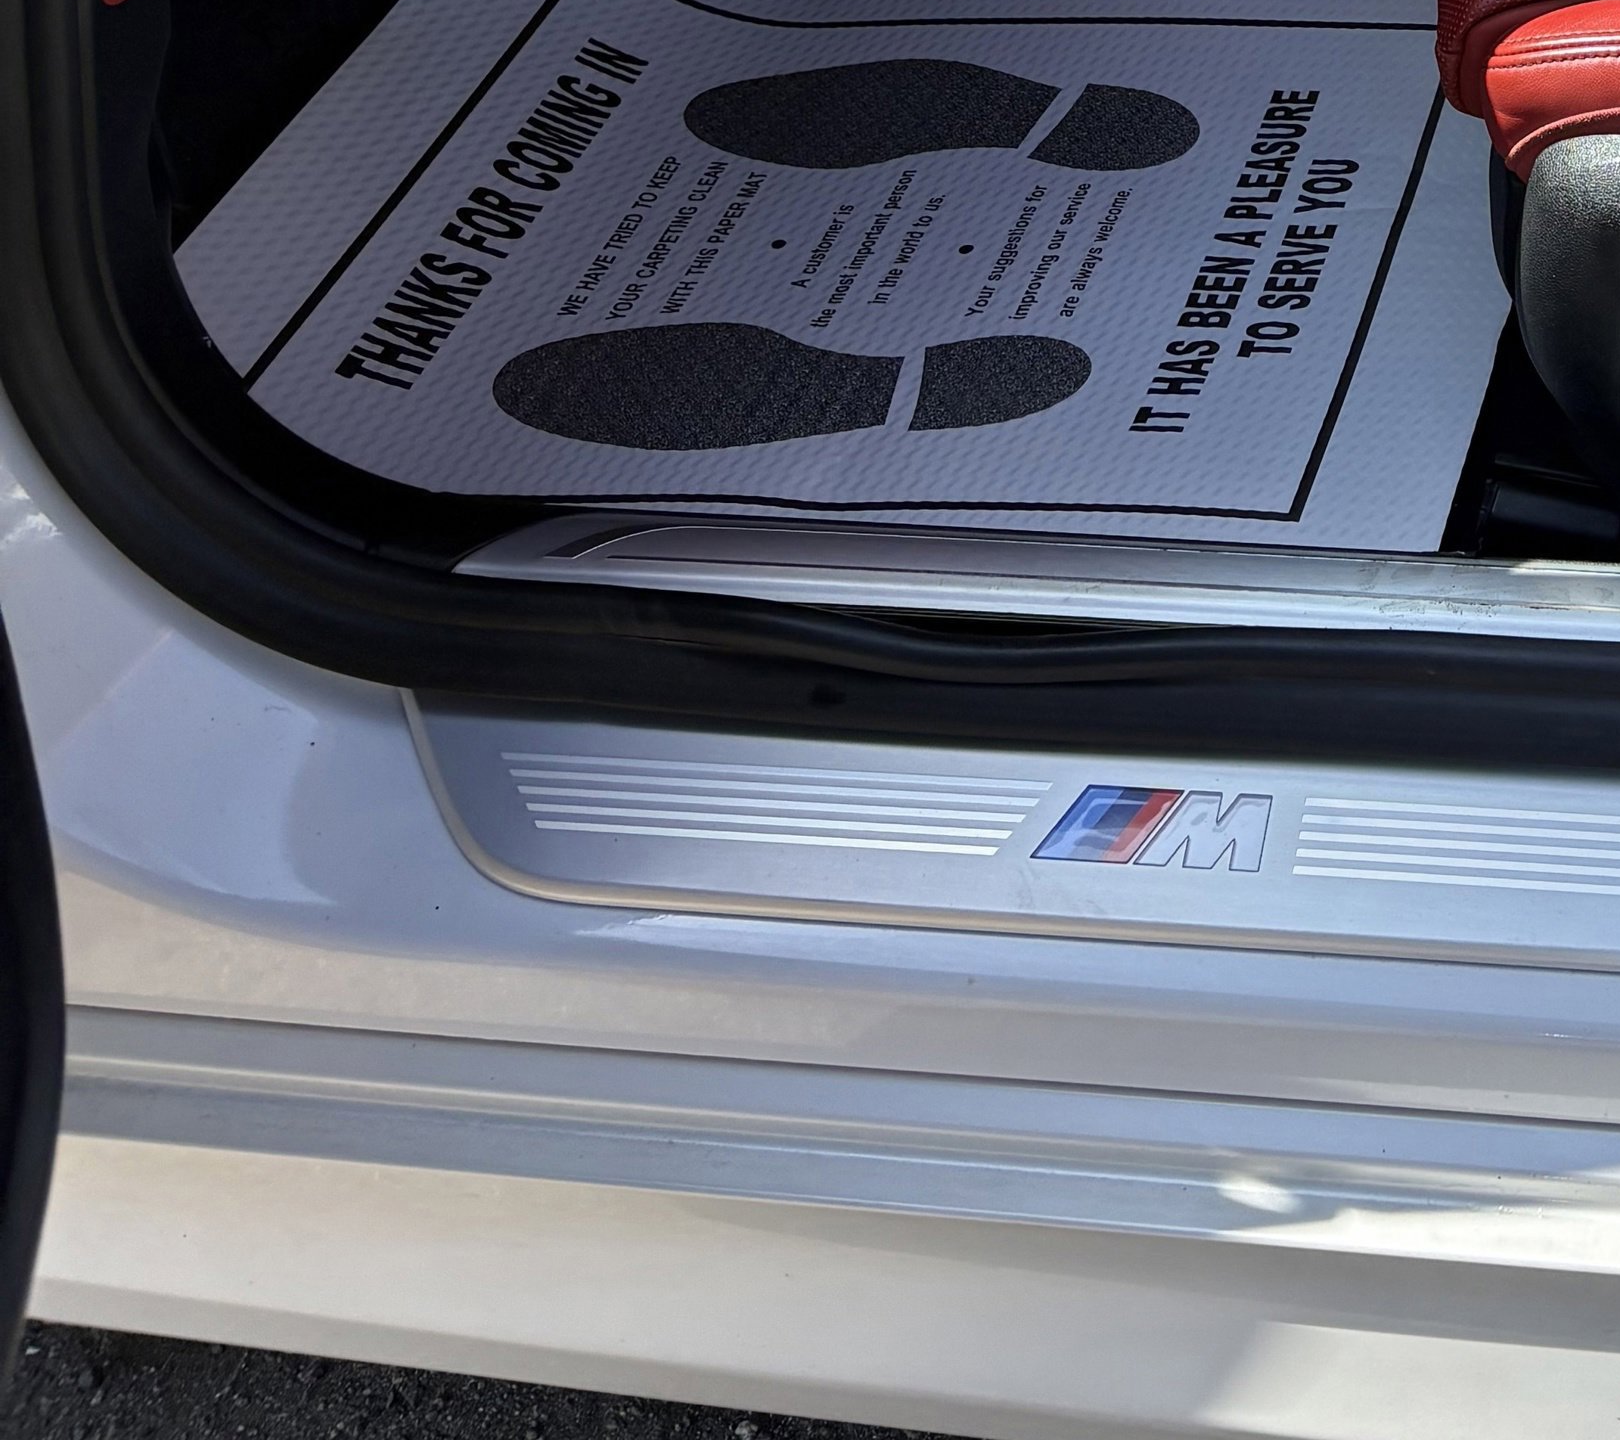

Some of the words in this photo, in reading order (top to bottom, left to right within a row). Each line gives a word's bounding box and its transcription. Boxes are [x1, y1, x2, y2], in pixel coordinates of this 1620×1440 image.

[1224, 90, 1320, 219] PLEASURE
[1294, 159, 1359, 213] YOU
[335, 253, 492, 390] THANKS
[440, 187, 543, 258] FOR
[493, 75, 621, 191] COMING
[575, 38, 649, 84] IN
[557, 295, 588, 315] WE
[576, 255, 616, 290] HAVE
[603, 214, 643, 250] TRIED
[631, 192, 657, 208] TO
[647, 156, 681, 189] KEEP
[605, 284, 647, 320] YOUR
[636, 207, 697, 278] CARPETING
[688, 162, 728, 201] CLEAN
[660, 282, 698, 313] WITH
[685, 249, 718, 276] THIS
[707, 202, 750, 243] PAPER
[737, 172, 767, 197] MAT
[912, 216, 933, 226] to
[925, 195, 945, 211] us.
[1214, 231, 1267, 248] A
[793, 279, 811, 288] A
[803, 219, 845, 274] customer
[838, 205, 854, 214] is
[810, 309, 836, 327] the
[828, 274, 857, 304] most
[843, 214, 893, 269] important
[884, 170, 917, 209] person
[878, 269, 903, 287] the
[894, 232, 924, 263] world
[965, 286, 995, 316] Your
[988, 206, 1037, 281] suggestions
[1025, 185, 1047, 202] for
[1008, 255, 1059, 319] improving
[1048, 230, 1067, 250] our
[1060, 184, 1091, 225] service
[1060, 297, 1079, 317] are
[1071, 248, 1102, 290] always
[1094, 191, 1130, 242] welcome.
[1258, 225, 1337, 310] SERVE
[867, 293, 890, 304] in
[1177, 256, 1255, 328] BEEN
[1147, 340, 1220, 395] HAS
[1237, 321, 1300, 357] TO
[1129, 407, 1190, 432] IT
[1133, 790, 1273, 872] M
